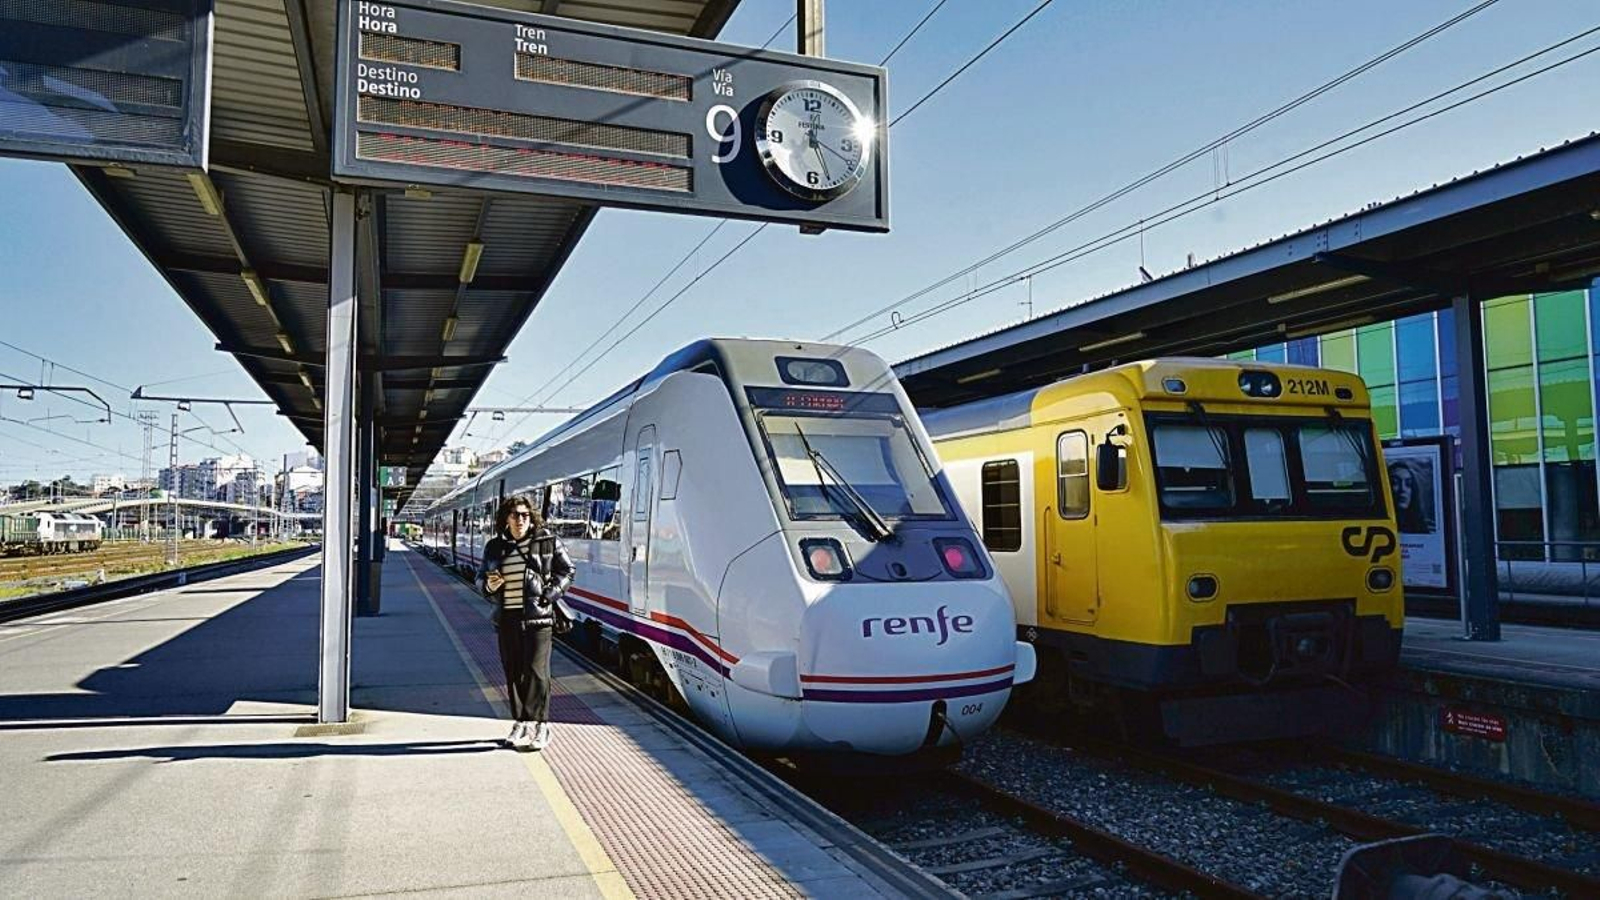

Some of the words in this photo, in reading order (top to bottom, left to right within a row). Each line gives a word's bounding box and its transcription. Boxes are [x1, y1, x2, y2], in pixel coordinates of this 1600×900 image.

[359, 2, 395, 19] Hora
[359, 16, 397, 34] Hora
[515, 24, 546, 41] Tren
[514, 38, 548, 55] Tren
[357, 63, 418, 84] Destino
[712, 68, 733, 83] Vía
[357, 78, 421, 99] Destino
[712, 82, 734, 97] Vía
[803, 98, 822, 114] 12
[705, 104, 742, 164] 9
[771, 130, 783, 144] 9
[840, 139, 852, 152] 3
[806, 171, 819, 185] 6
[1287, 379, 1330, 396] 212M
[862, 605, 974, 646] renfe
[961, 703, 983, 716] 004
